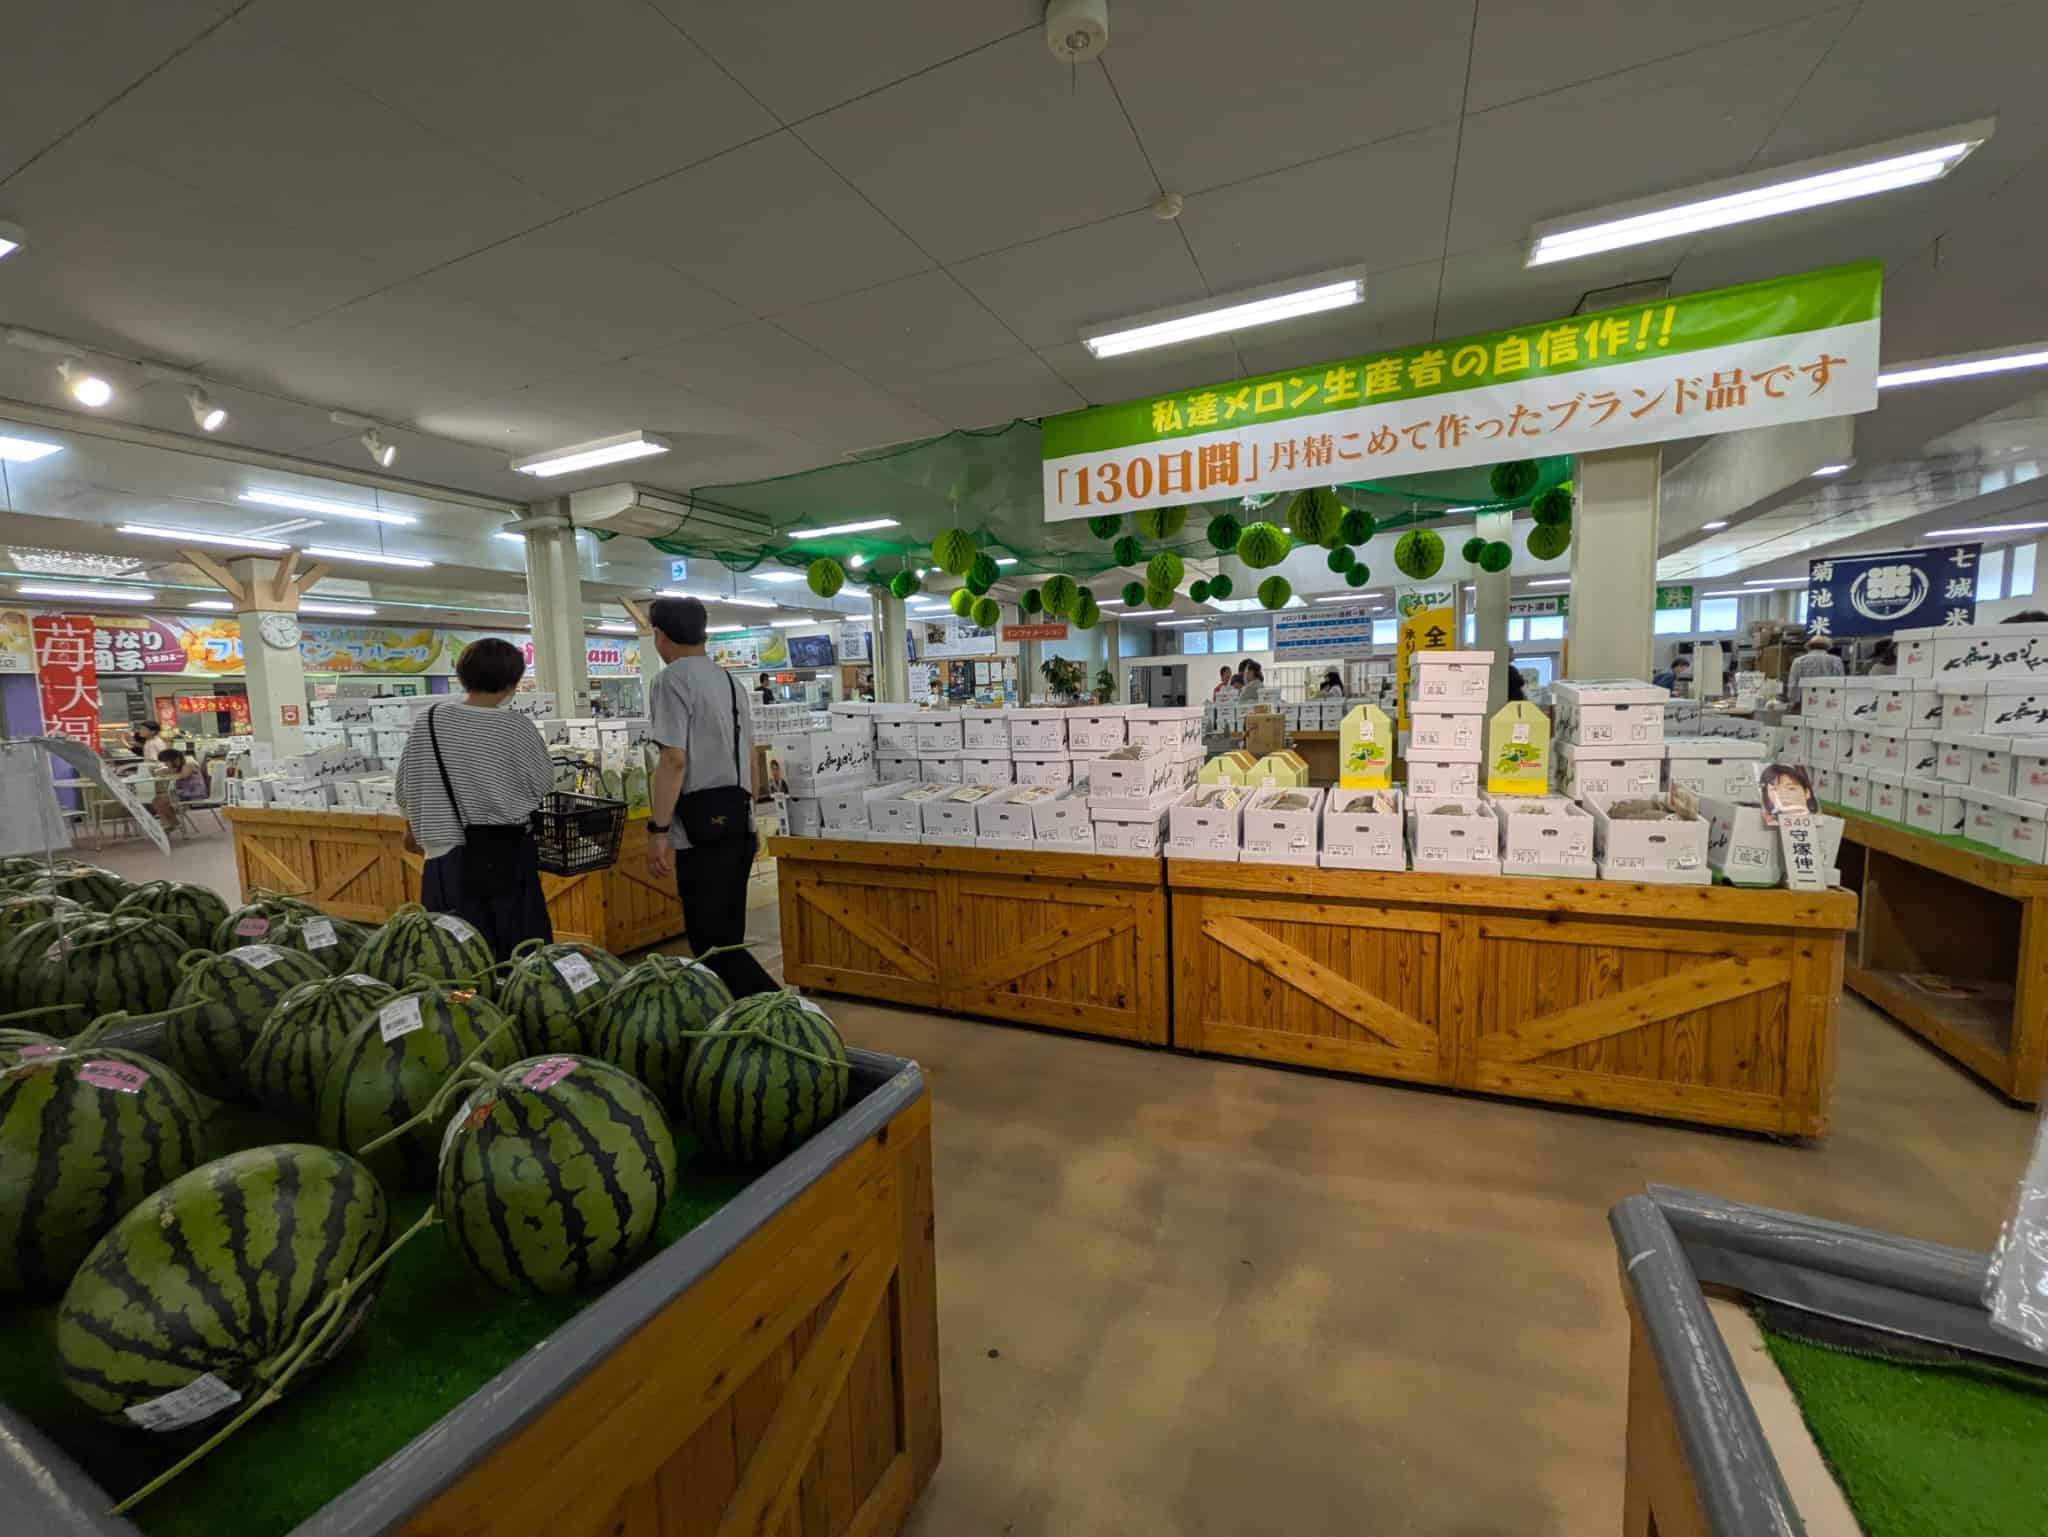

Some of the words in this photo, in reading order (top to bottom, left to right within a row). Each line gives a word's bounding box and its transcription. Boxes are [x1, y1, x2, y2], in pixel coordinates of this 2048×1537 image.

[1808, 561, 1835, 635] 菊池米
[1945, 547, 1977, 627] 七城米
[1783, 817, 1811, 827] 340
